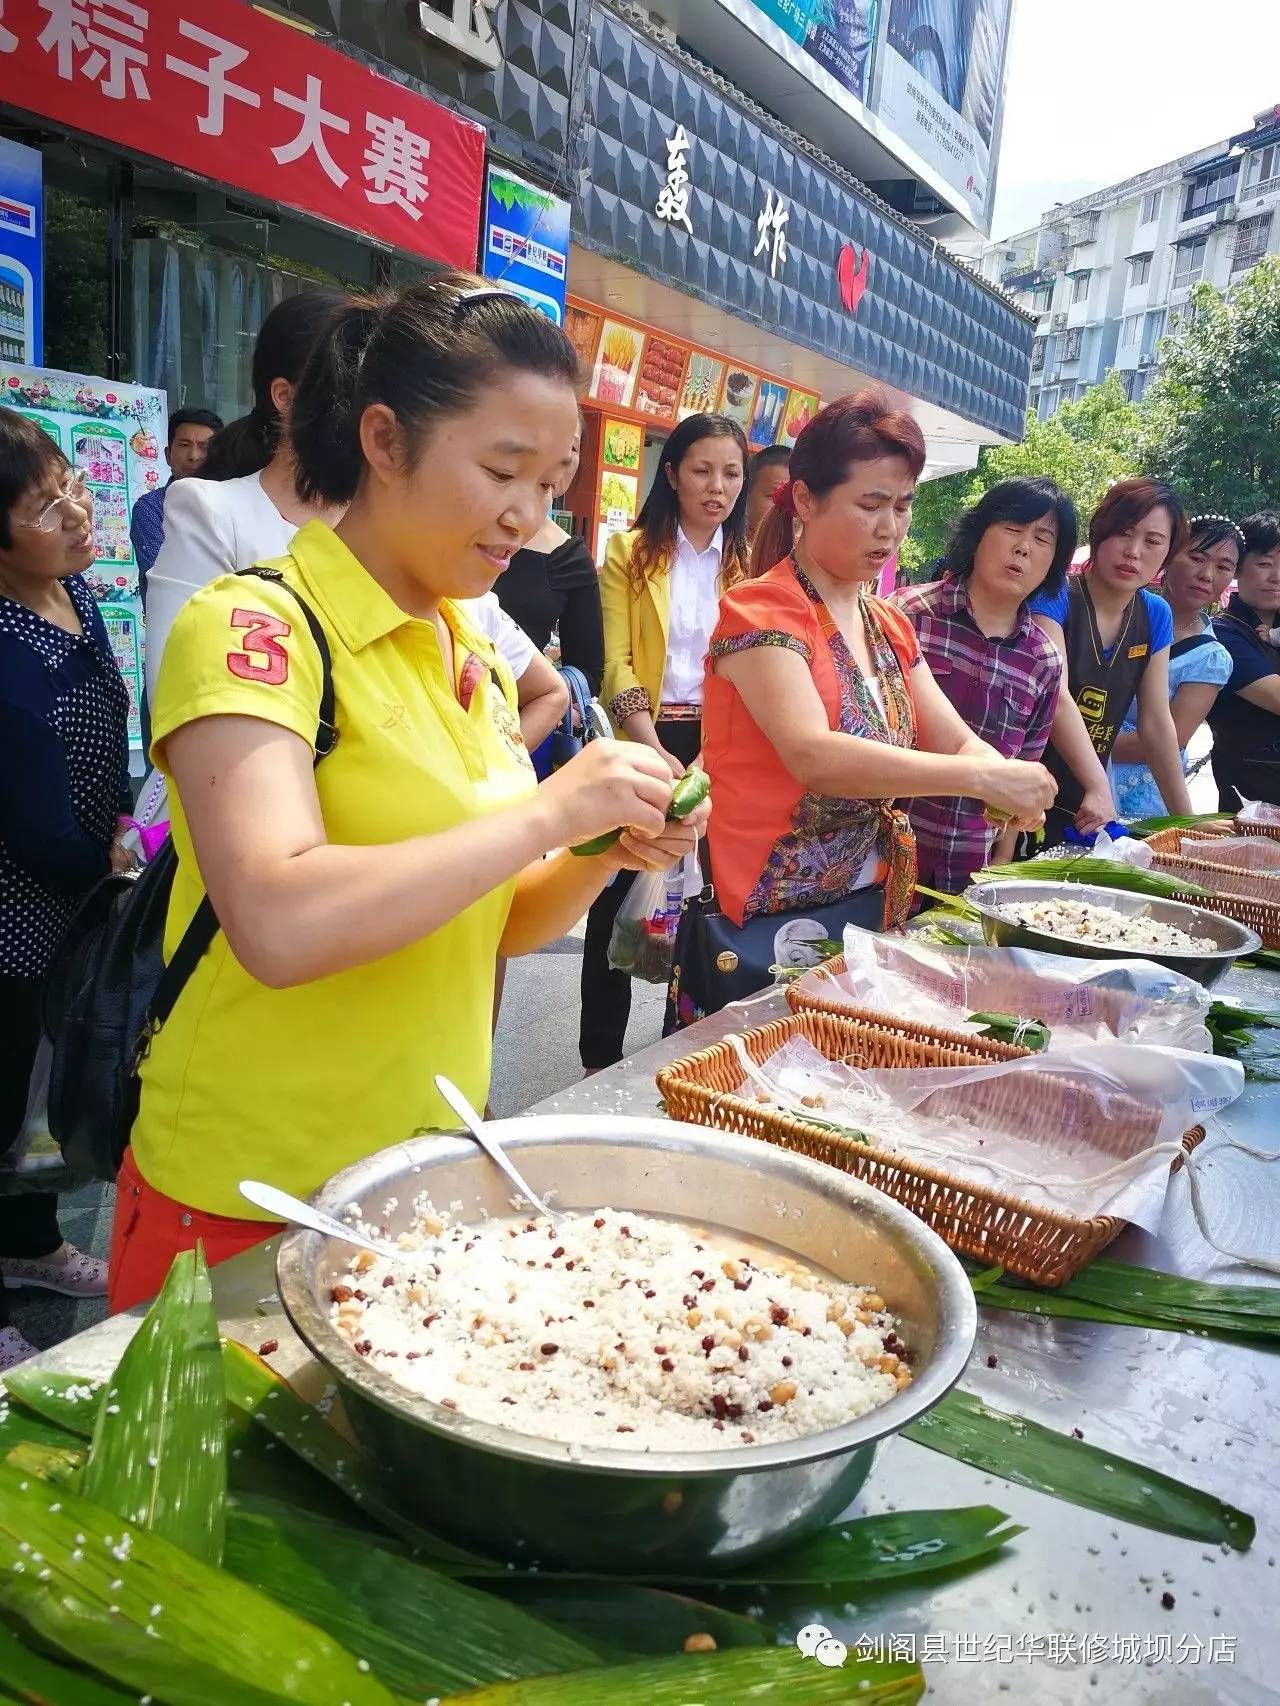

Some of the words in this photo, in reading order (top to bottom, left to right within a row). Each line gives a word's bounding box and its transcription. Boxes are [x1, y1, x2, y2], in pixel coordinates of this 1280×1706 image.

[0, 0, 431, 221] 粽子大赛
[227, 608, 291, 685] 3
